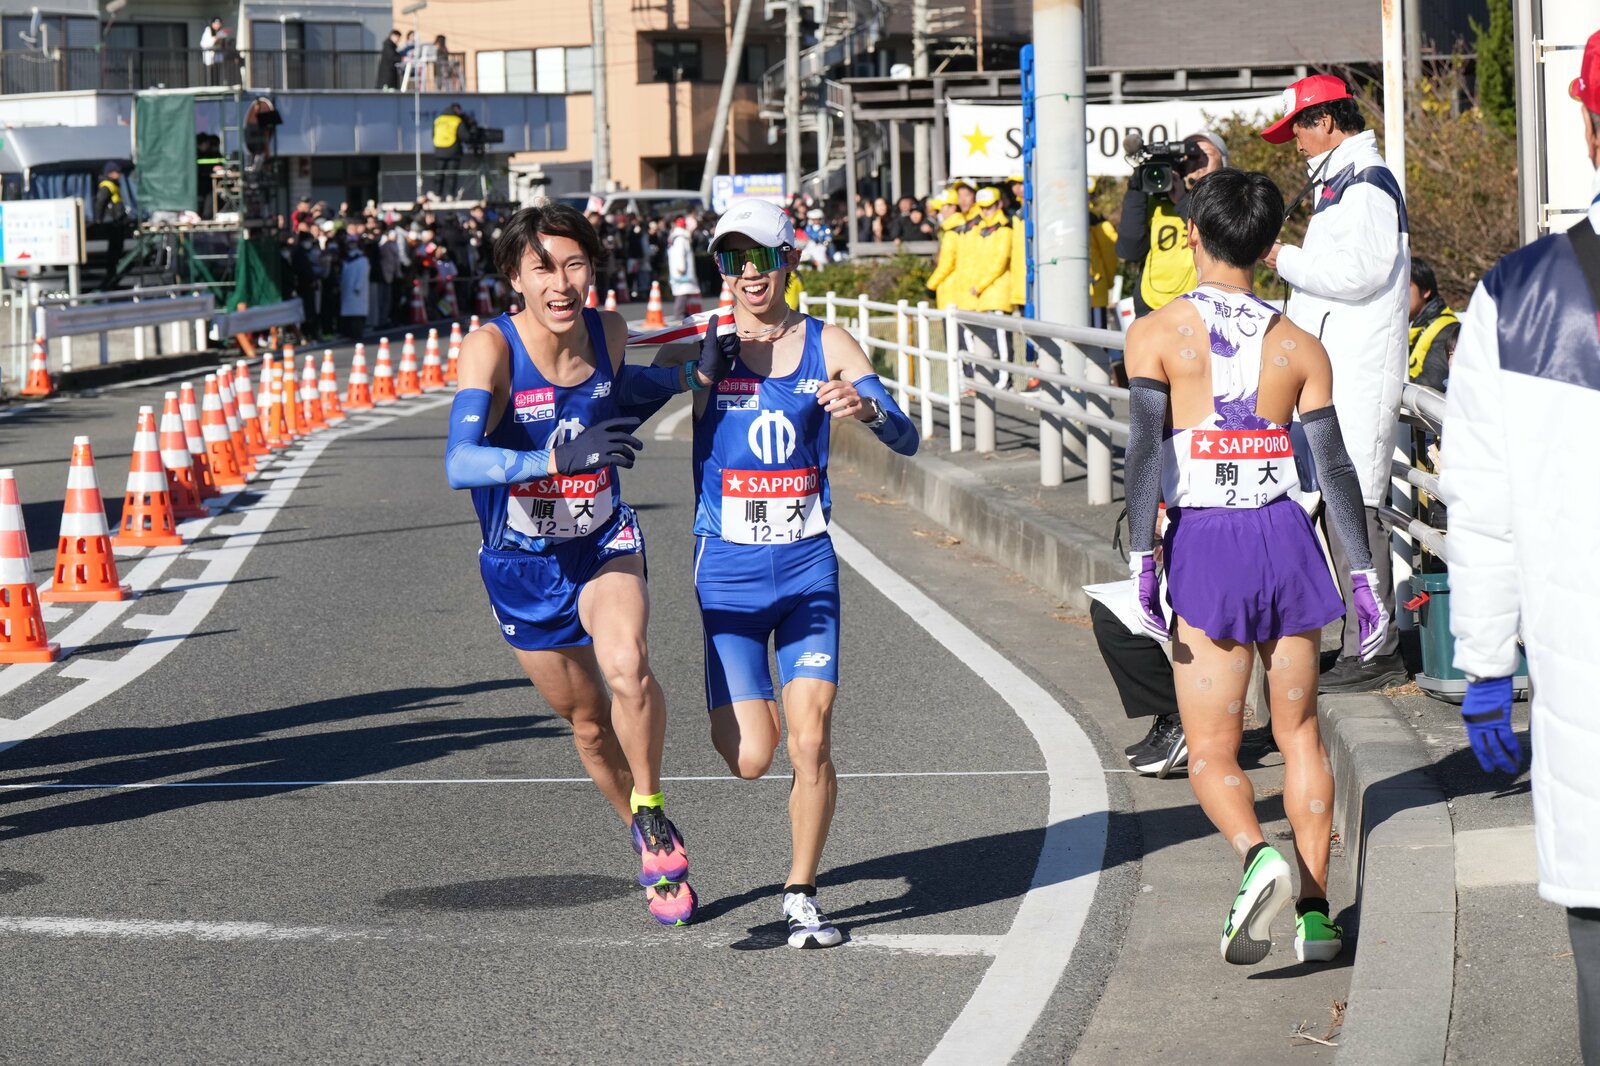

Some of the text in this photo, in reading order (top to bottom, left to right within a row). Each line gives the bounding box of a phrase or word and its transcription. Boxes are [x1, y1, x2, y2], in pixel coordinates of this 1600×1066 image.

[730, 382, 758, 392] 印西市
[526, 391, 554, 404] 印西市
[718, 399, 758, 409] EXEO
[515, 408, 554, 422] EXEO
[1218, 435, 1289, 455] SAPPORO
[747, 473, 817, 493] SAPPORO
[1225, 489, 1268, 506] 2-13
[536, 520, 588, 536] 12-15
[751, 525, 802, 542] 12-14
